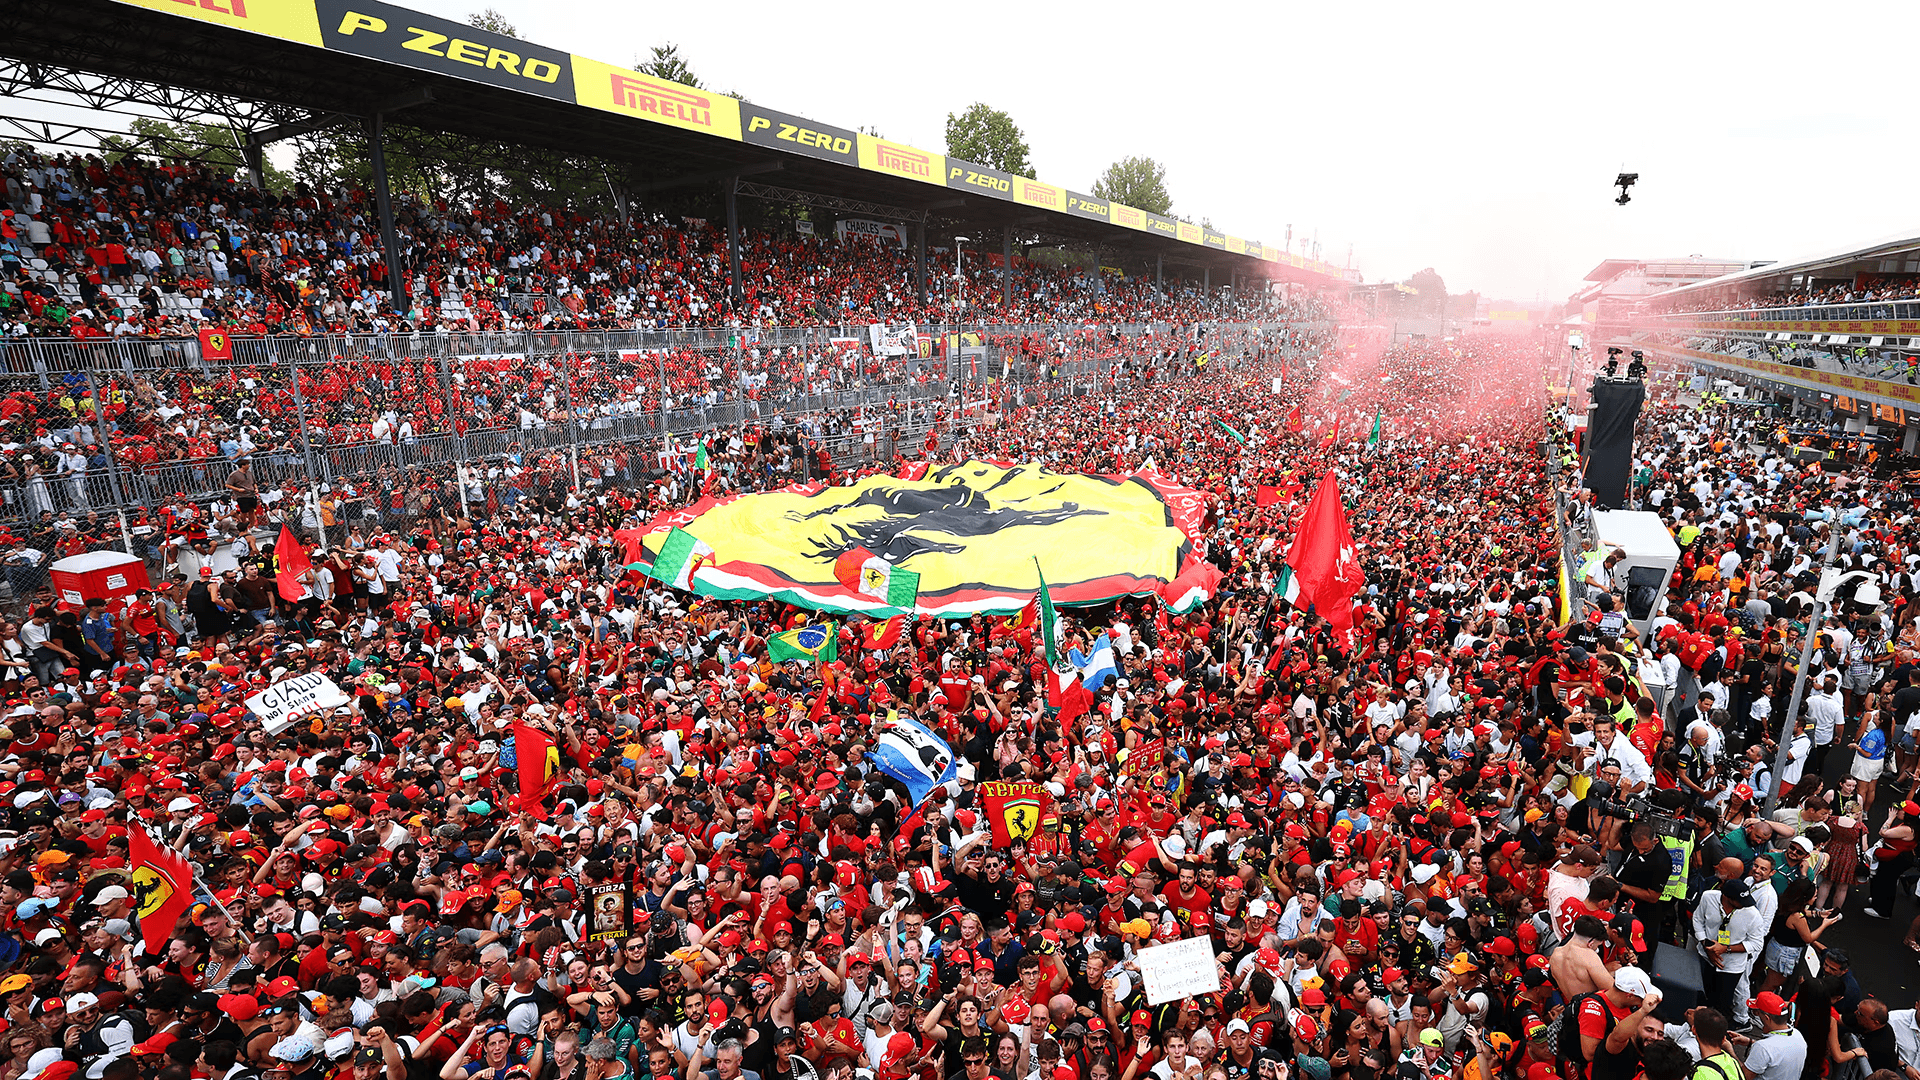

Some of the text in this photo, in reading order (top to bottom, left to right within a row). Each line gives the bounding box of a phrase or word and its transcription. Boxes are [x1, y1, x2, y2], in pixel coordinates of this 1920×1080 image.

[337, 11, 562, 85] P ZERO
[610, 73, 711, 126] PIRELLI
[748, 116, 852, 154] P ZERO
[877, 144, 929, 177] PIRELLI
[950, 167, 1010, 193] P ZERO
[1024, 183, 1056, 206] PIRELLI
[1068, 198, 1108, 216] P ZERO
[846, 221, 879, 234] CHARLES
[266, 708, 284, 721] NOI
[1672, 864, 1682, 873] 39
[592, 883, 626, 895] FORZA
